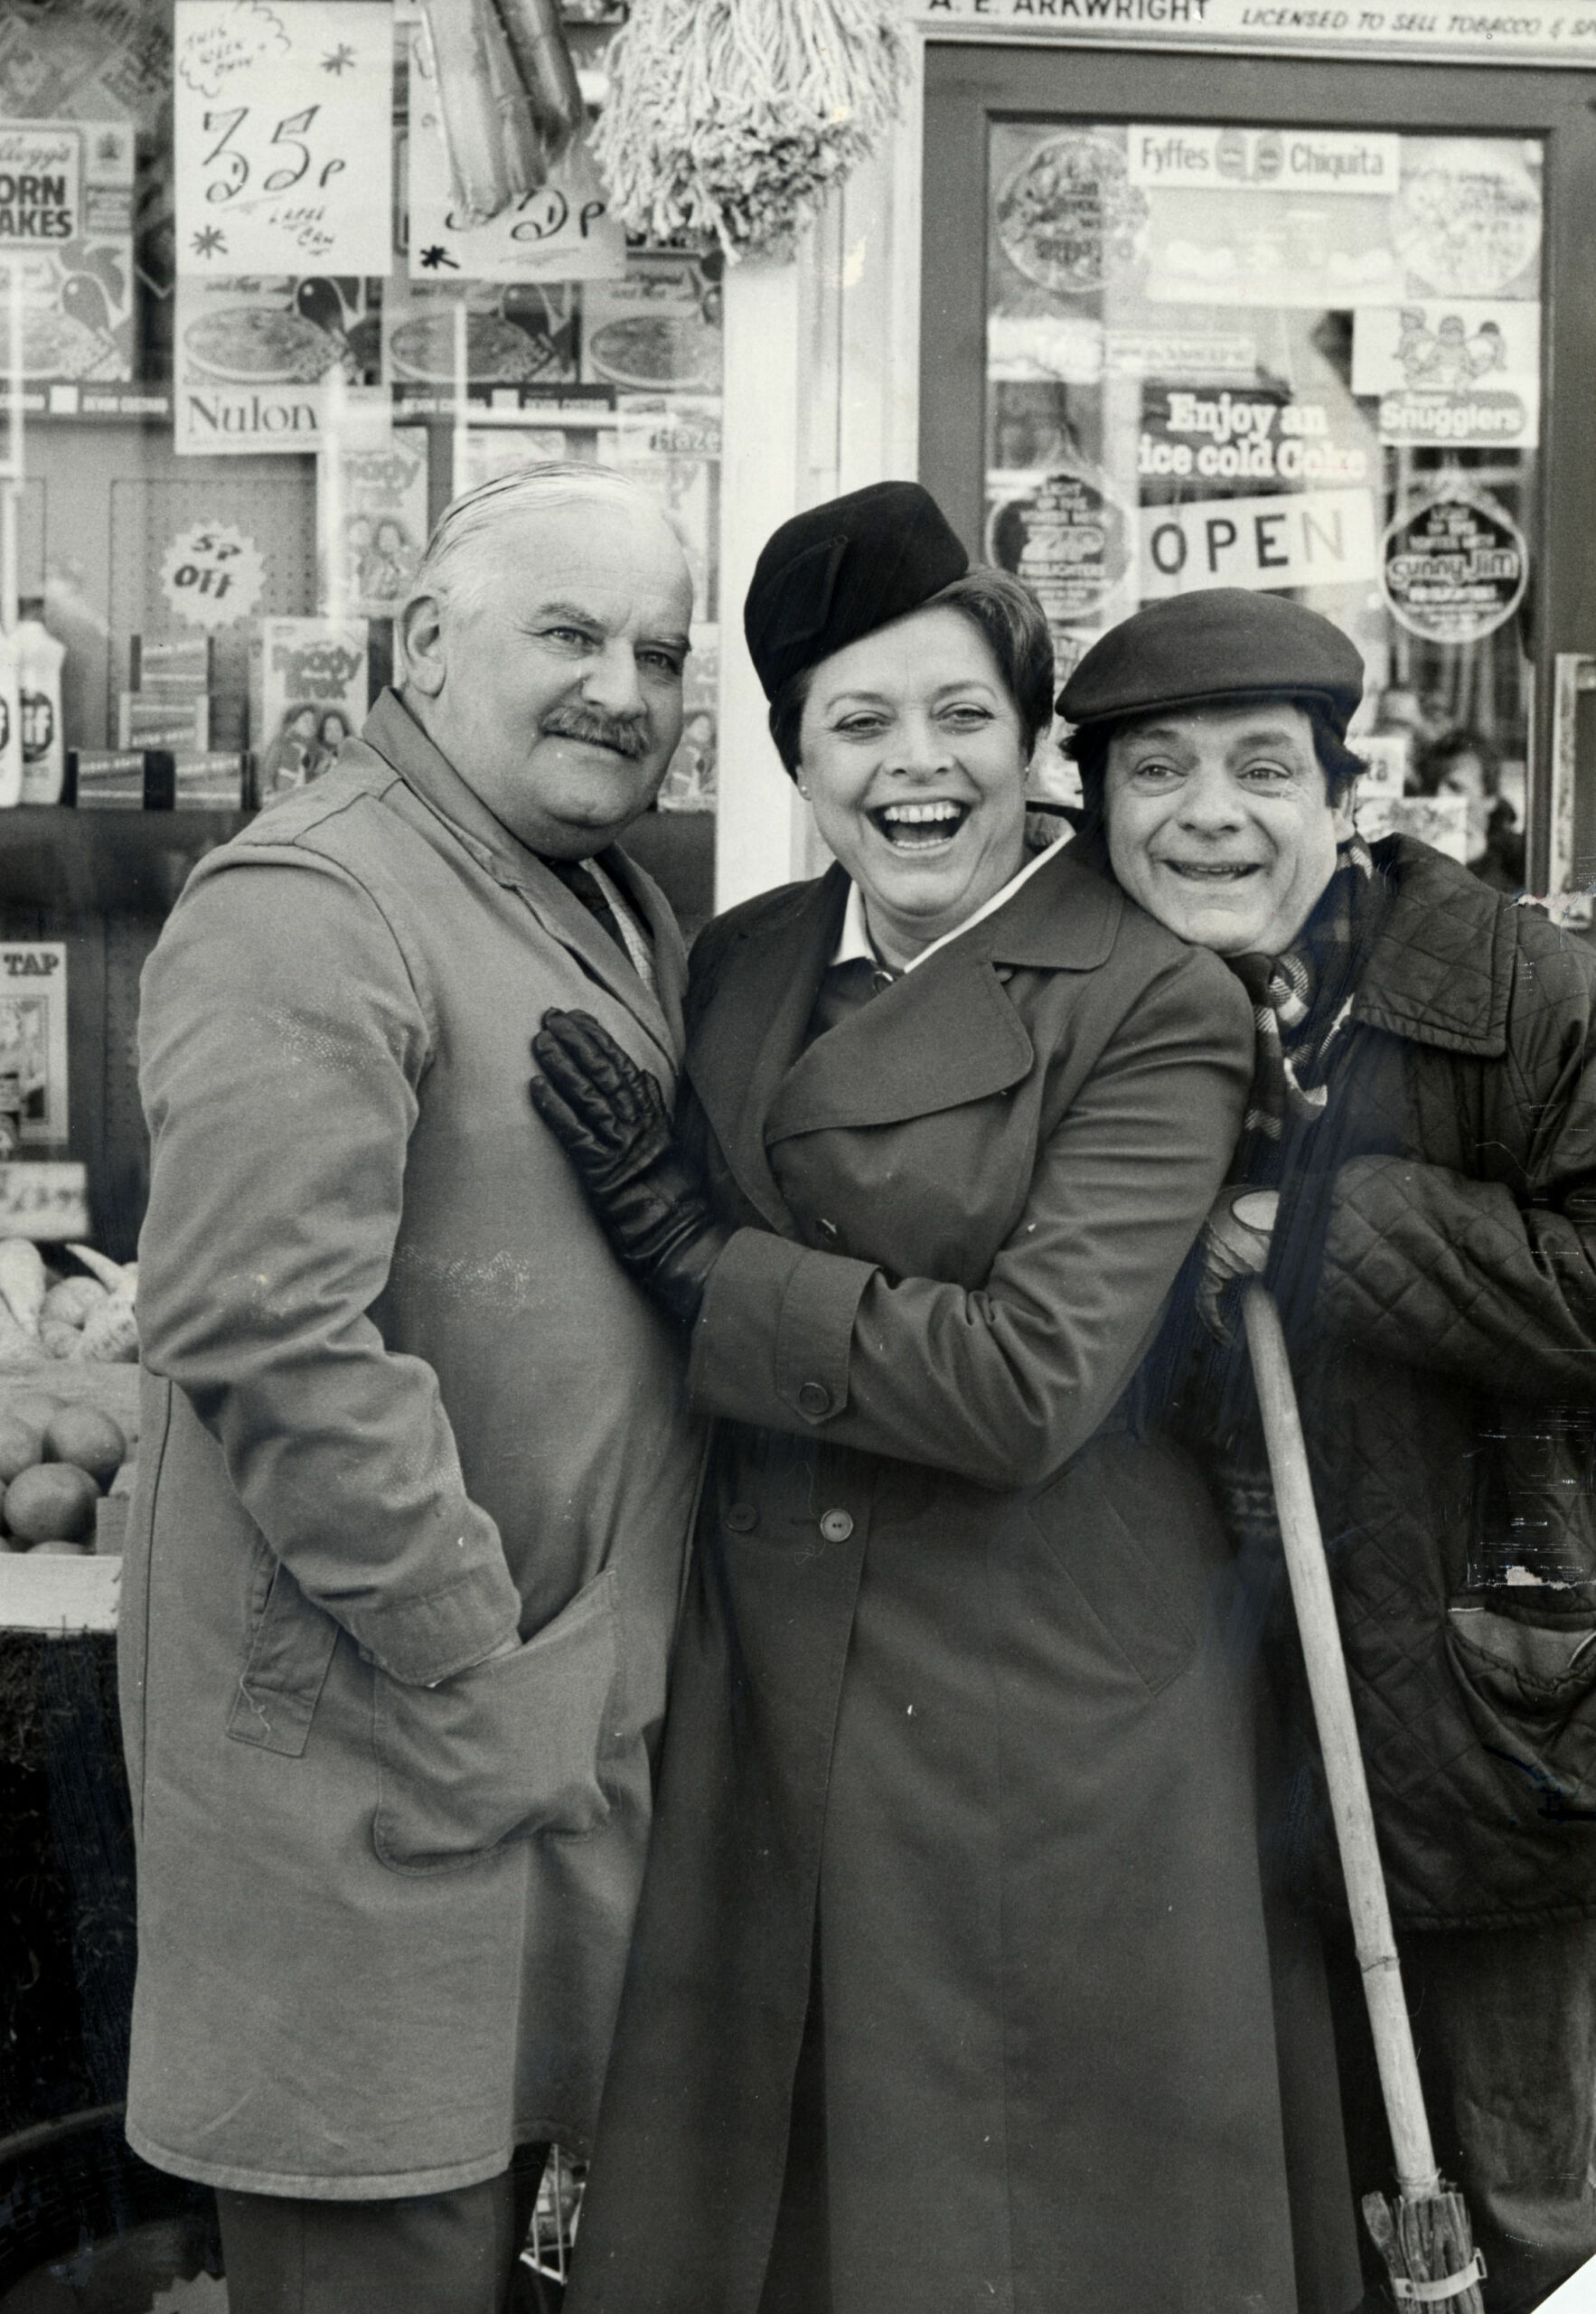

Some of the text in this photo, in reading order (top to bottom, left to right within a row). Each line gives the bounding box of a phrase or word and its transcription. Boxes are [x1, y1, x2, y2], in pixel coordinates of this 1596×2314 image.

[1012, 0, 1207, 21] ARKWRIGHT
[1241, 8, 1349, 30] LICENSED
[1357, 13, 1386, 30] TO
[1391, 14, 1438, 33] SELL
[1448, 15, 1543, 35] TOBACCO
[1141, 136, 1384, 179] Fyffes Chiquita
[189, 395, 318, 433] Nulon
[1167, 392, 1330, 442] Enjoy an
[1379, 400, 1525, 438] Snugglers
[1138, 434, 1367, 478] ice cold Coke
[1150, 510, 1346, 576] OPEN
[1389, 548, 1520, 590] Sunny Jim
[4, 952, 60, 977] TAP
